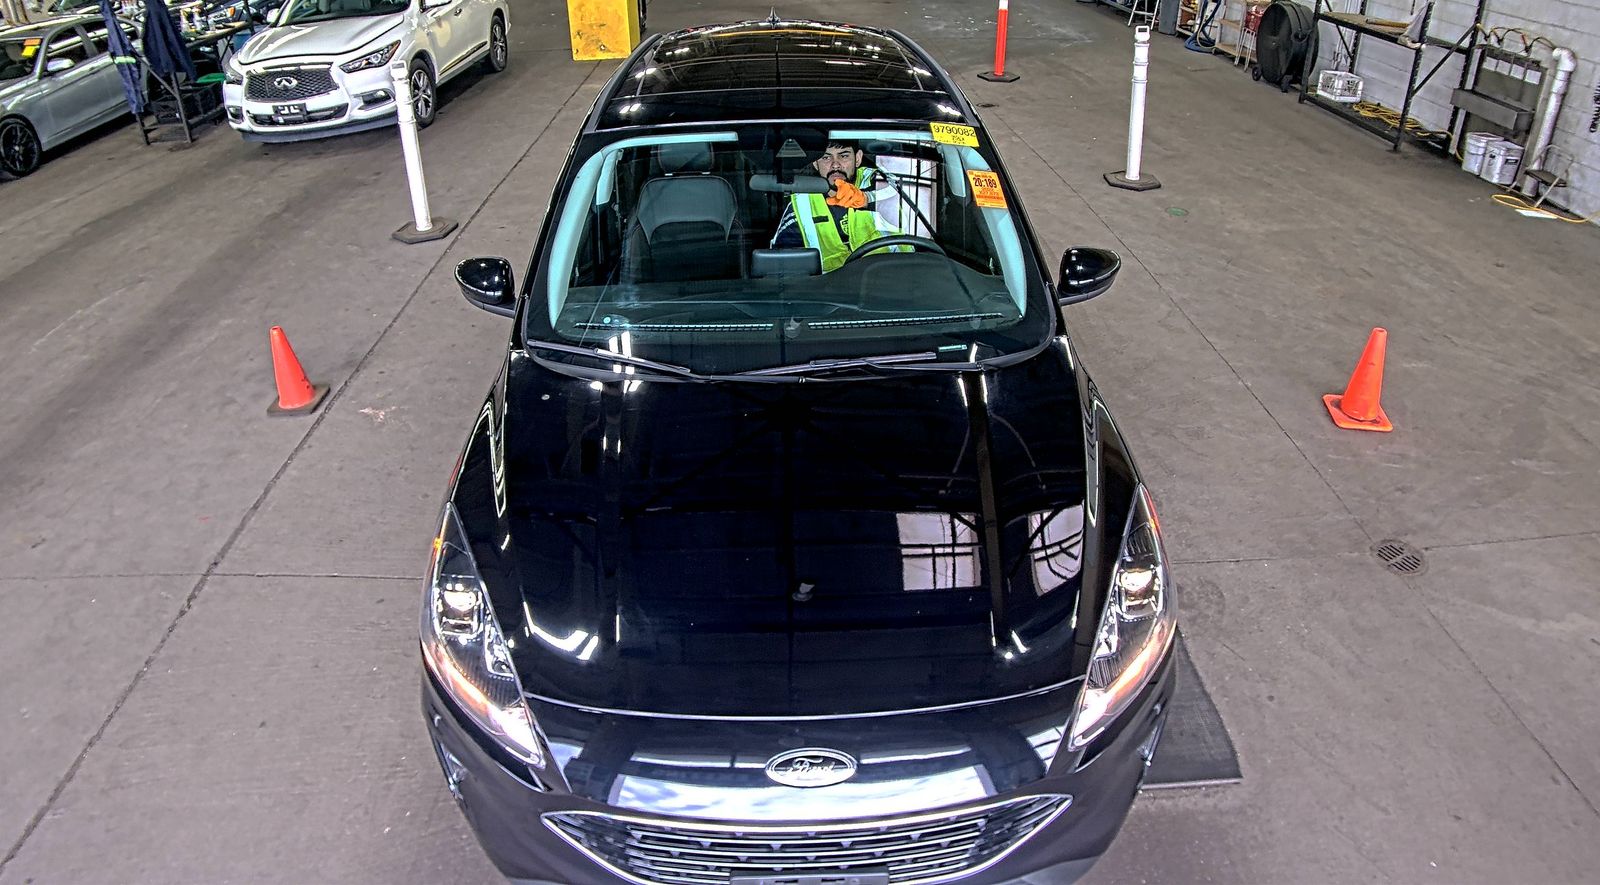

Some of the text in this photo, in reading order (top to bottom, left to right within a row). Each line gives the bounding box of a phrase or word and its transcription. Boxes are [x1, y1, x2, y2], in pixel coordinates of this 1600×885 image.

[933, 125, 976, 137] 9790082
[973, 177, 998, 188] 20:189
[786, 757, 836, 774] Ford
